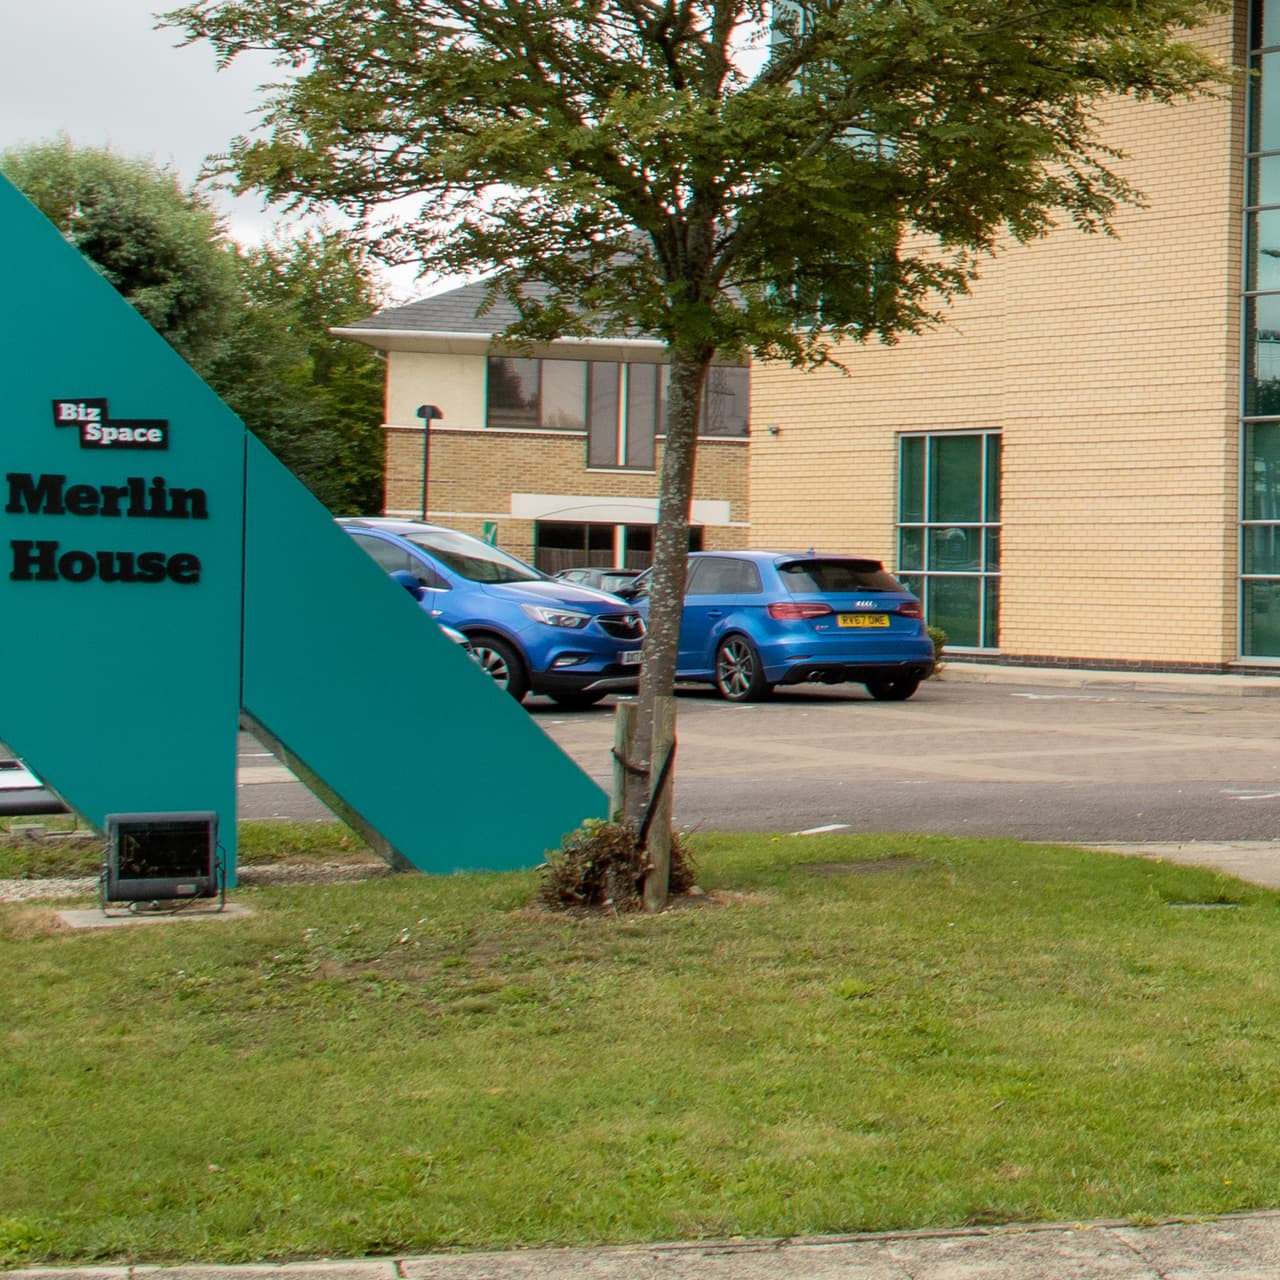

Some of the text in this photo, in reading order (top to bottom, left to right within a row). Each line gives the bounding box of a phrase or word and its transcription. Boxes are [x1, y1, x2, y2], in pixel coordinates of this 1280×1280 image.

[59, 403, 101, 421] Biz
[86, 423, 162, 444] Space
[5, 473, 208, 520] Merlin
[9, 540, 201, 584] House
